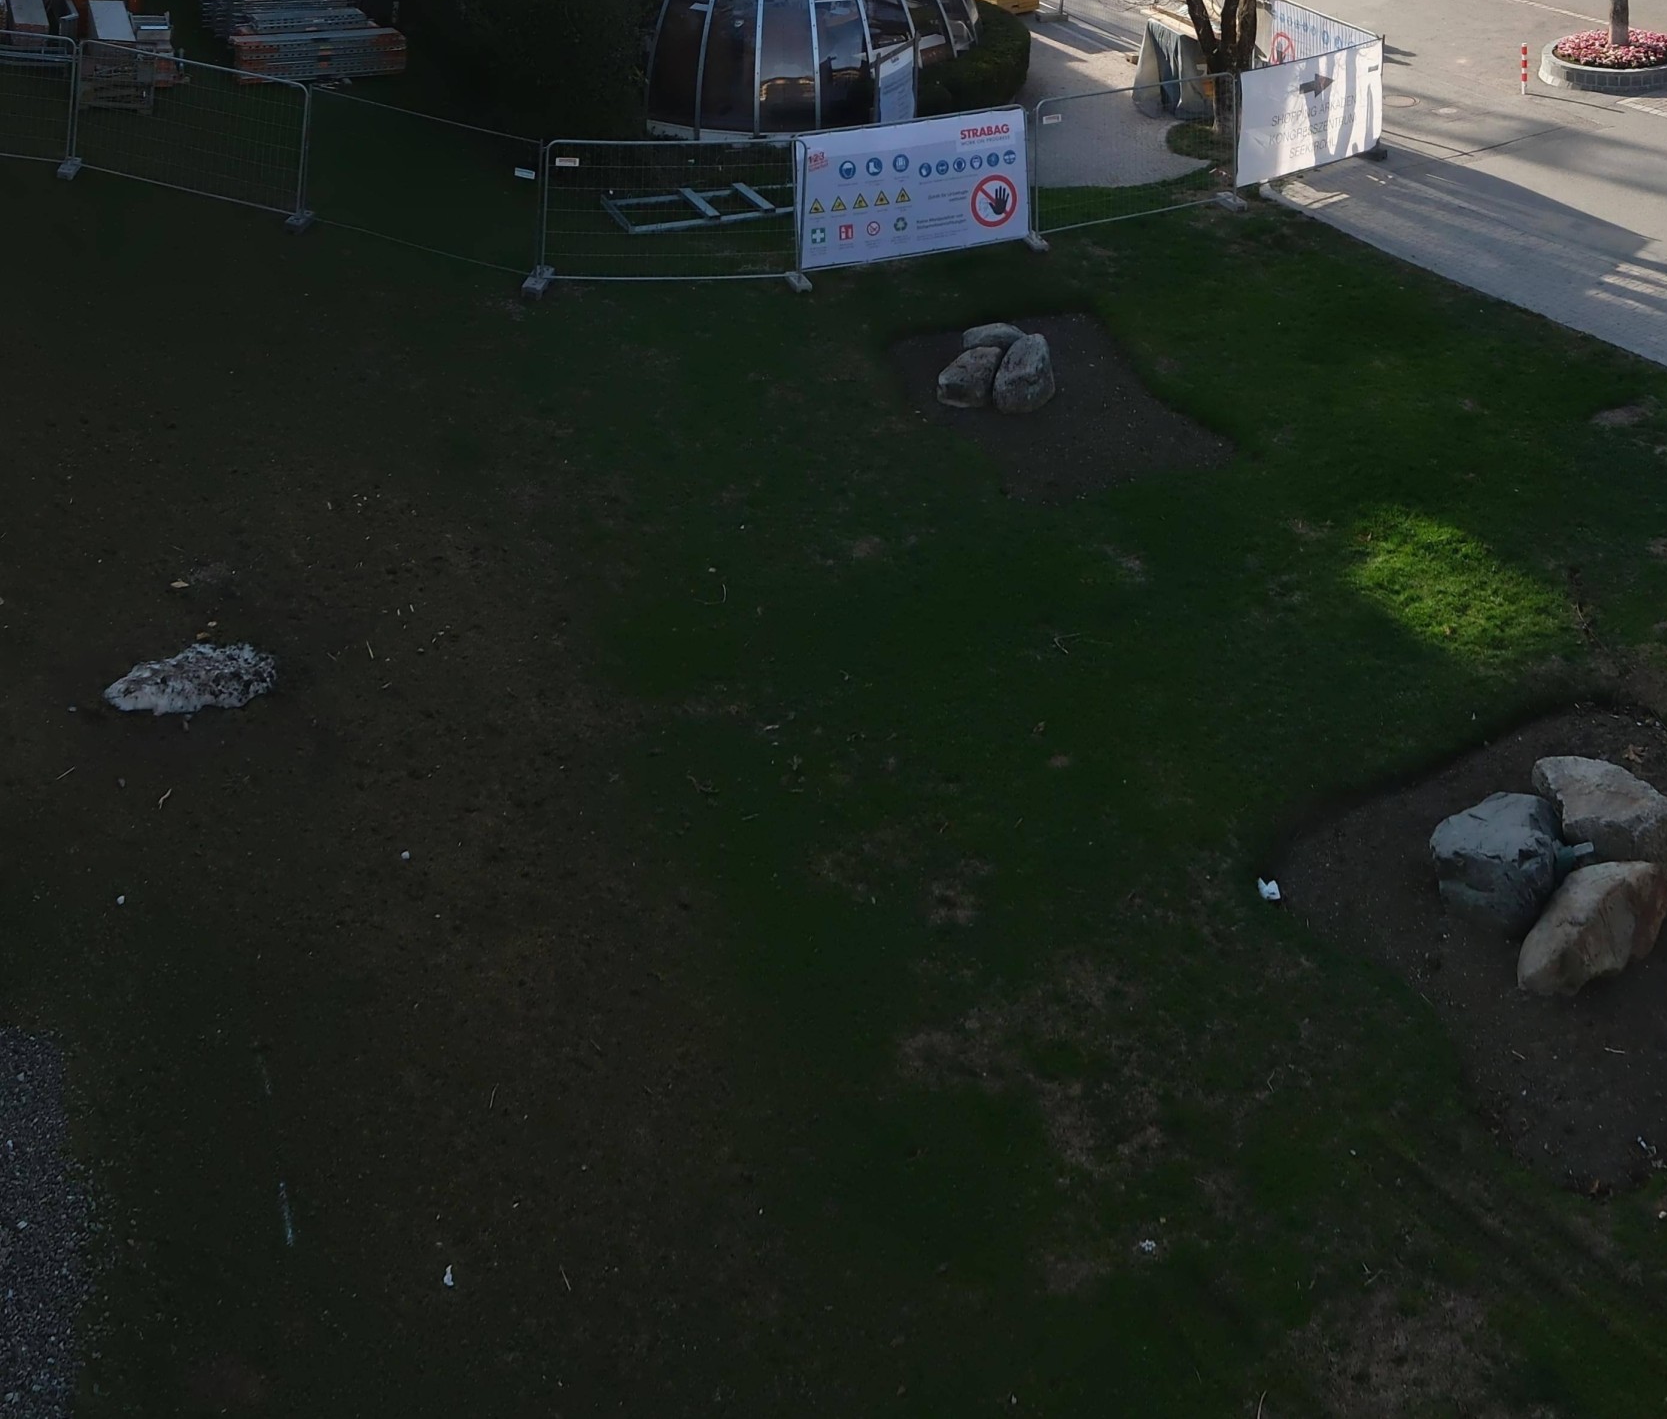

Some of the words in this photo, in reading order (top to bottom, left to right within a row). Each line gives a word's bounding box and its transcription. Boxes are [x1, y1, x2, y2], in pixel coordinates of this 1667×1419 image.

[1271, 106, 1318, 127] SHOPPING
[1318, 94, 1357, 116] ARKADEN
[960, 124, 1010, 140] STRABAG
[1269, 113, 1355, 146] KONGRESSZENTRUM
